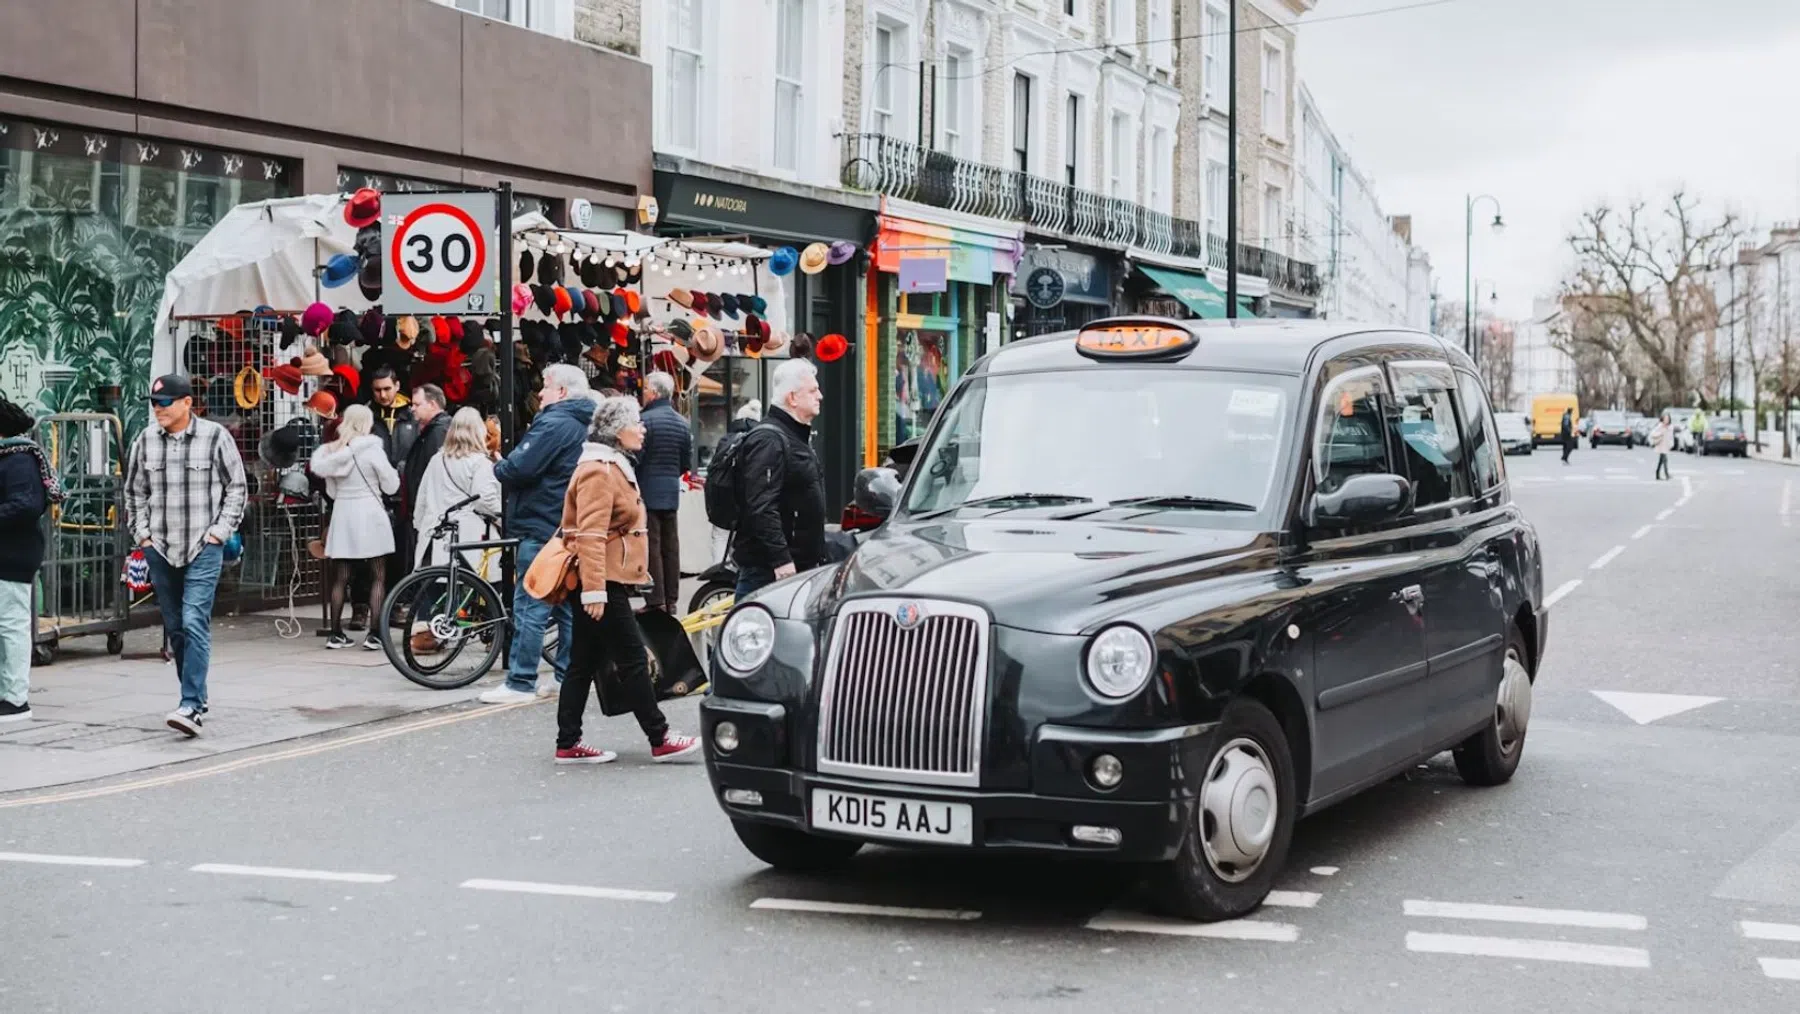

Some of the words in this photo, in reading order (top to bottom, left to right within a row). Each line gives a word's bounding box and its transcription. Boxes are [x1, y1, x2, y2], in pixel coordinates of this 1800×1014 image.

[714, 195, 747, 213] NATOORA
[406, 233, 471, 273] 30
[1097, 328, 1162, 347] TAXI
[829, 794, 887, 828] KD15
[896, 803, 952, 834] AAJ
